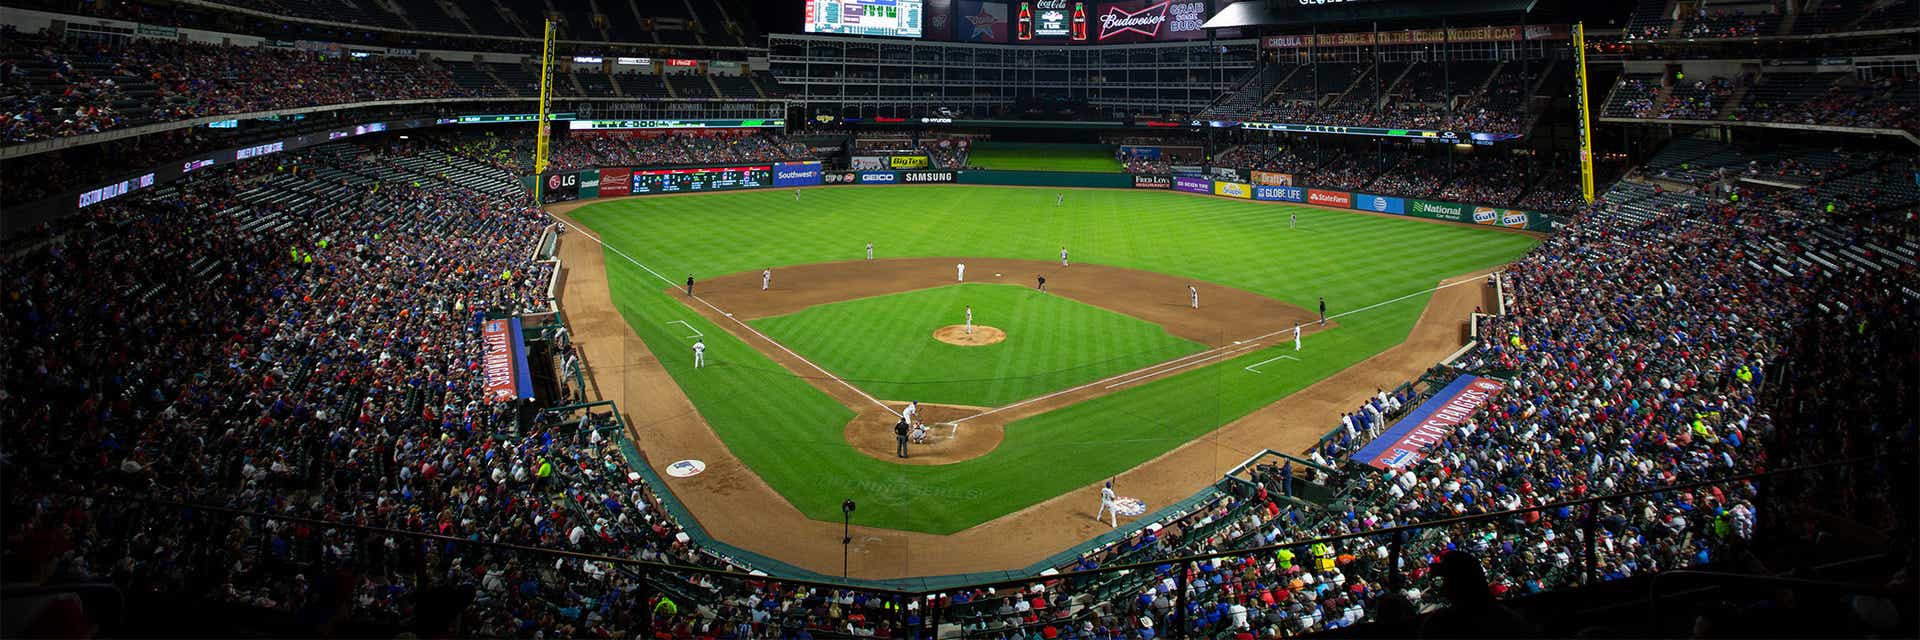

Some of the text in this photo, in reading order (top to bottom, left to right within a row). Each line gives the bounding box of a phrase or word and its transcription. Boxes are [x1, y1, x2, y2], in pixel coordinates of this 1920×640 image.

[1169, 2, 1205, 14] GRAB
[1100, 12, 1166, 29] Budweiser
[1268, 38, 1301, 47] CHOLULA
[1338, 33, 1366, 45] SAUCE
[1392, 32, 1410, 43] THE
[1413, 31, 1445, 42] ICONIC
[1447, 29, 1494, 40] WOODEN
[1494, 28, 1516, 39] CAP
[562, 175, 576, 186] LG
[778, 171, 812, 180] Southwest
[862, 173, 894, 181] GEICO
[905, 172, 952, 182] SAMSUNG
[1265, 188, 1301, 200] GLOBE LIFE
[1423, 203, 1461, 216] National
[1474, 212, 1497, 222] Gulf
[1503, 214, 1526, 225] Gulf
[488, 354, 511, 387] RANGERS
[1402, 389, 1489, 448] TEXAS RANGERS
